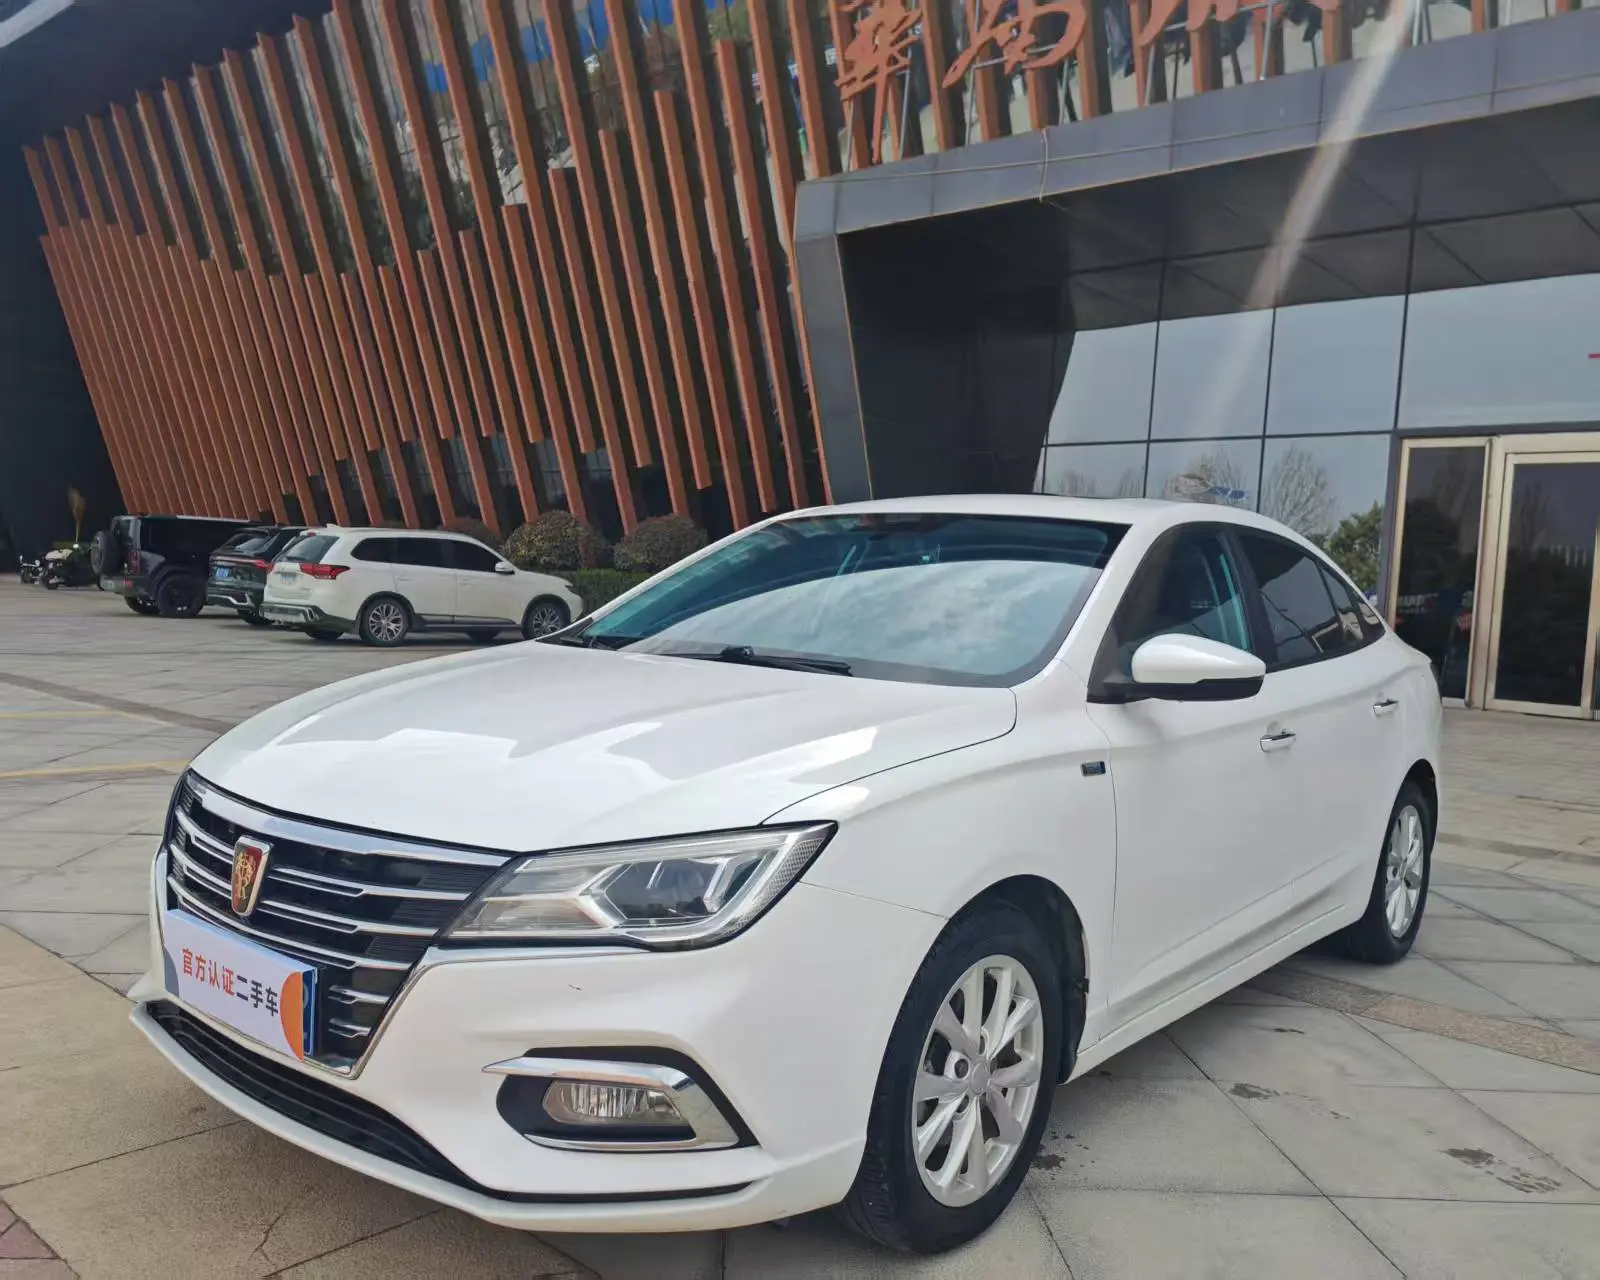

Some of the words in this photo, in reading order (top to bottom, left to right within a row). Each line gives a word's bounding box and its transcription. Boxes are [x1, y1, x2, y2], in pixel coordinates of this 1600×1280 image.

[182, 948, 279, 1017] 官方认证二手车
